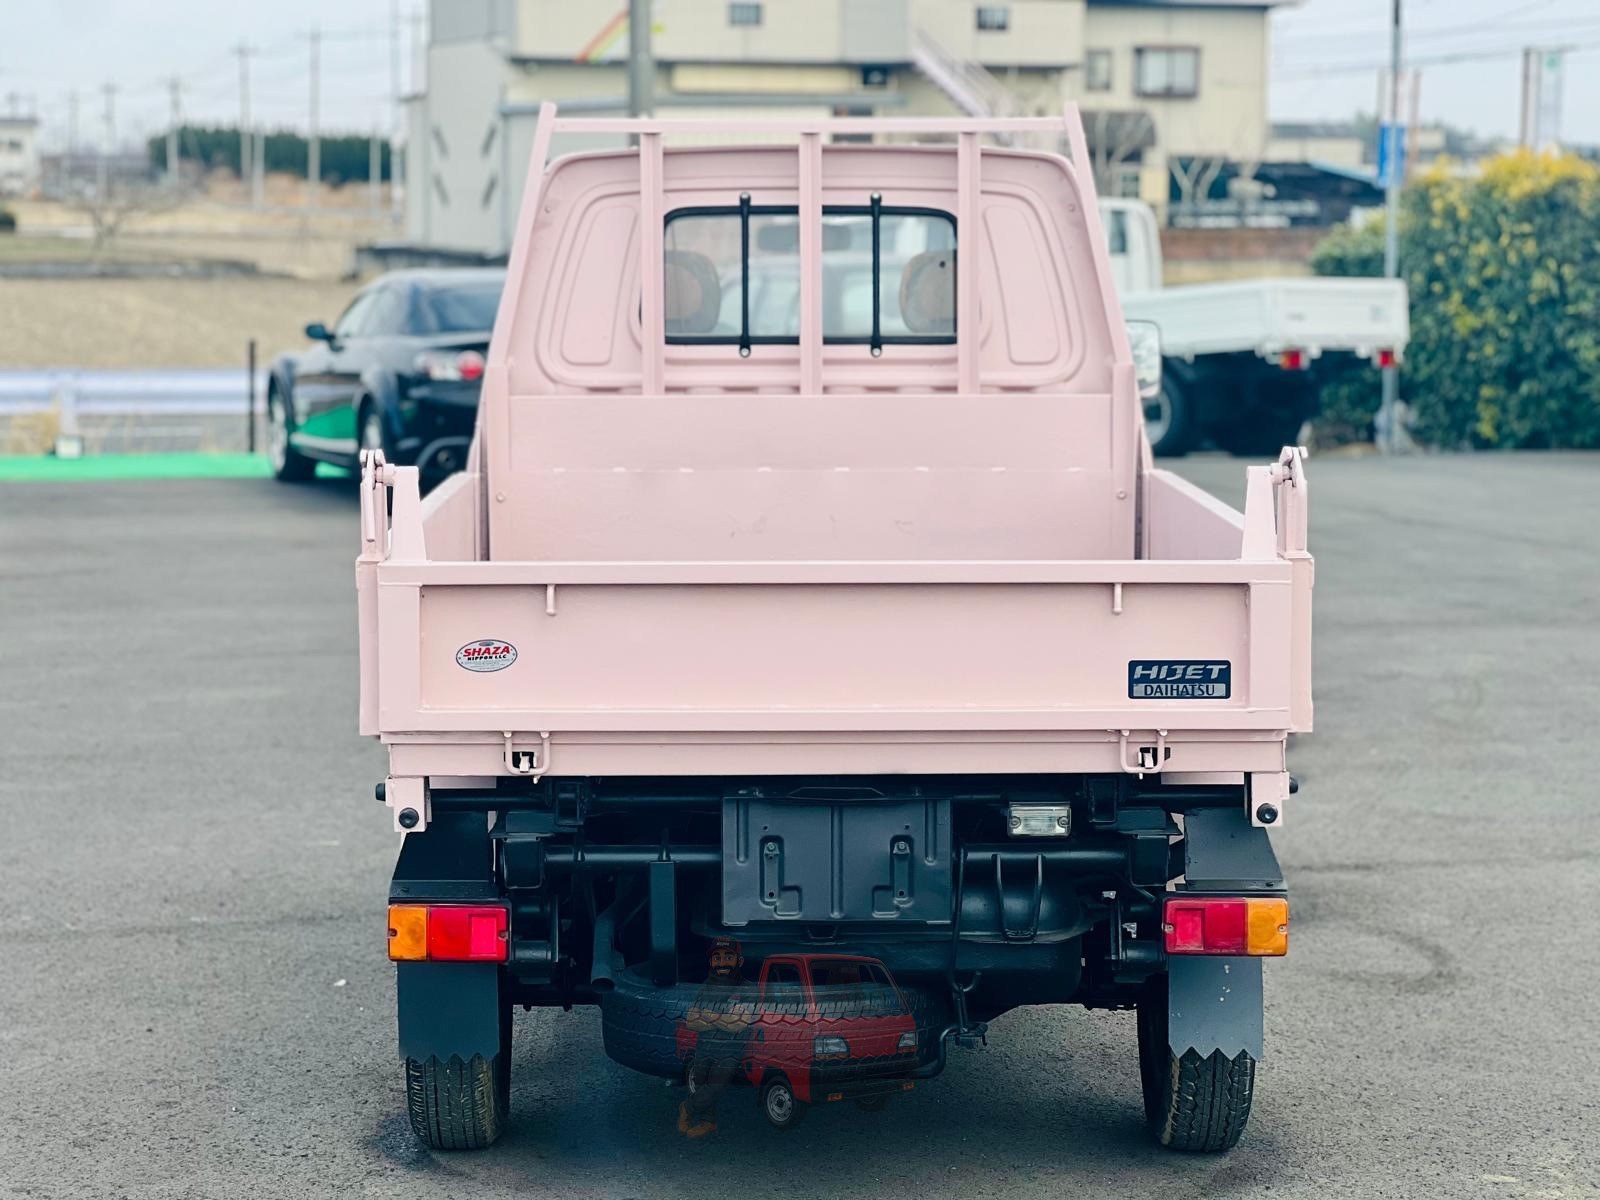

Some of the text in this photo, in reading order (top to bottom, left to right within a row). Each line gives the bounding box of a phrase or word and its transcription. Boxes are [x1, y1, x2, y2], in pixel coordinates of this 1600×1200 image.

[463, 646, 510, 657] SHAZA
[1133, 665, 1228, 680] HIJET
[1144, 684, 1215, 696] DAIHATSU
